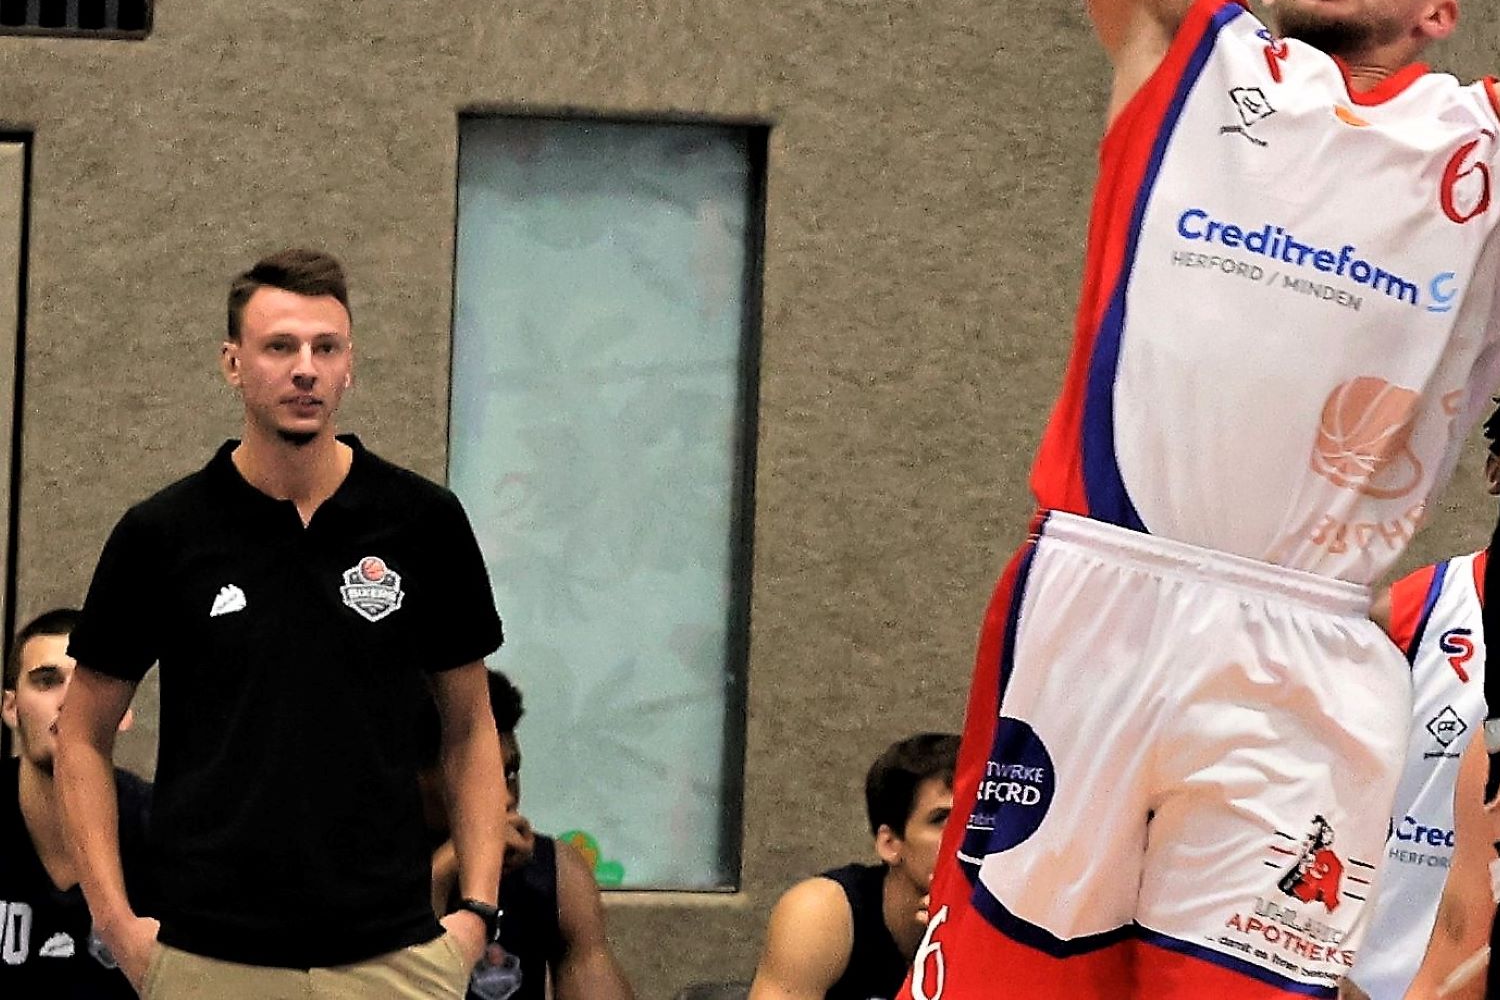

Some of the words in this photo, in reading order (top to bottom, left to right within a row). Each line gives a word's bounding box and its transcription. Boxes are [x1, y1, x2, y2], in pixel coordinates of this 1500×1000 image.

[1440, 128, 1496, 224] 6
[1171, 250, 1264, 281] HERFORD
[1282, 275, 1363, 311] MINDEN
[1177, 208, 1420, 304] Creditreform
[911, 904, 949, 1000] 6
[1225, 913, 1355, 968] APOTHEKE
